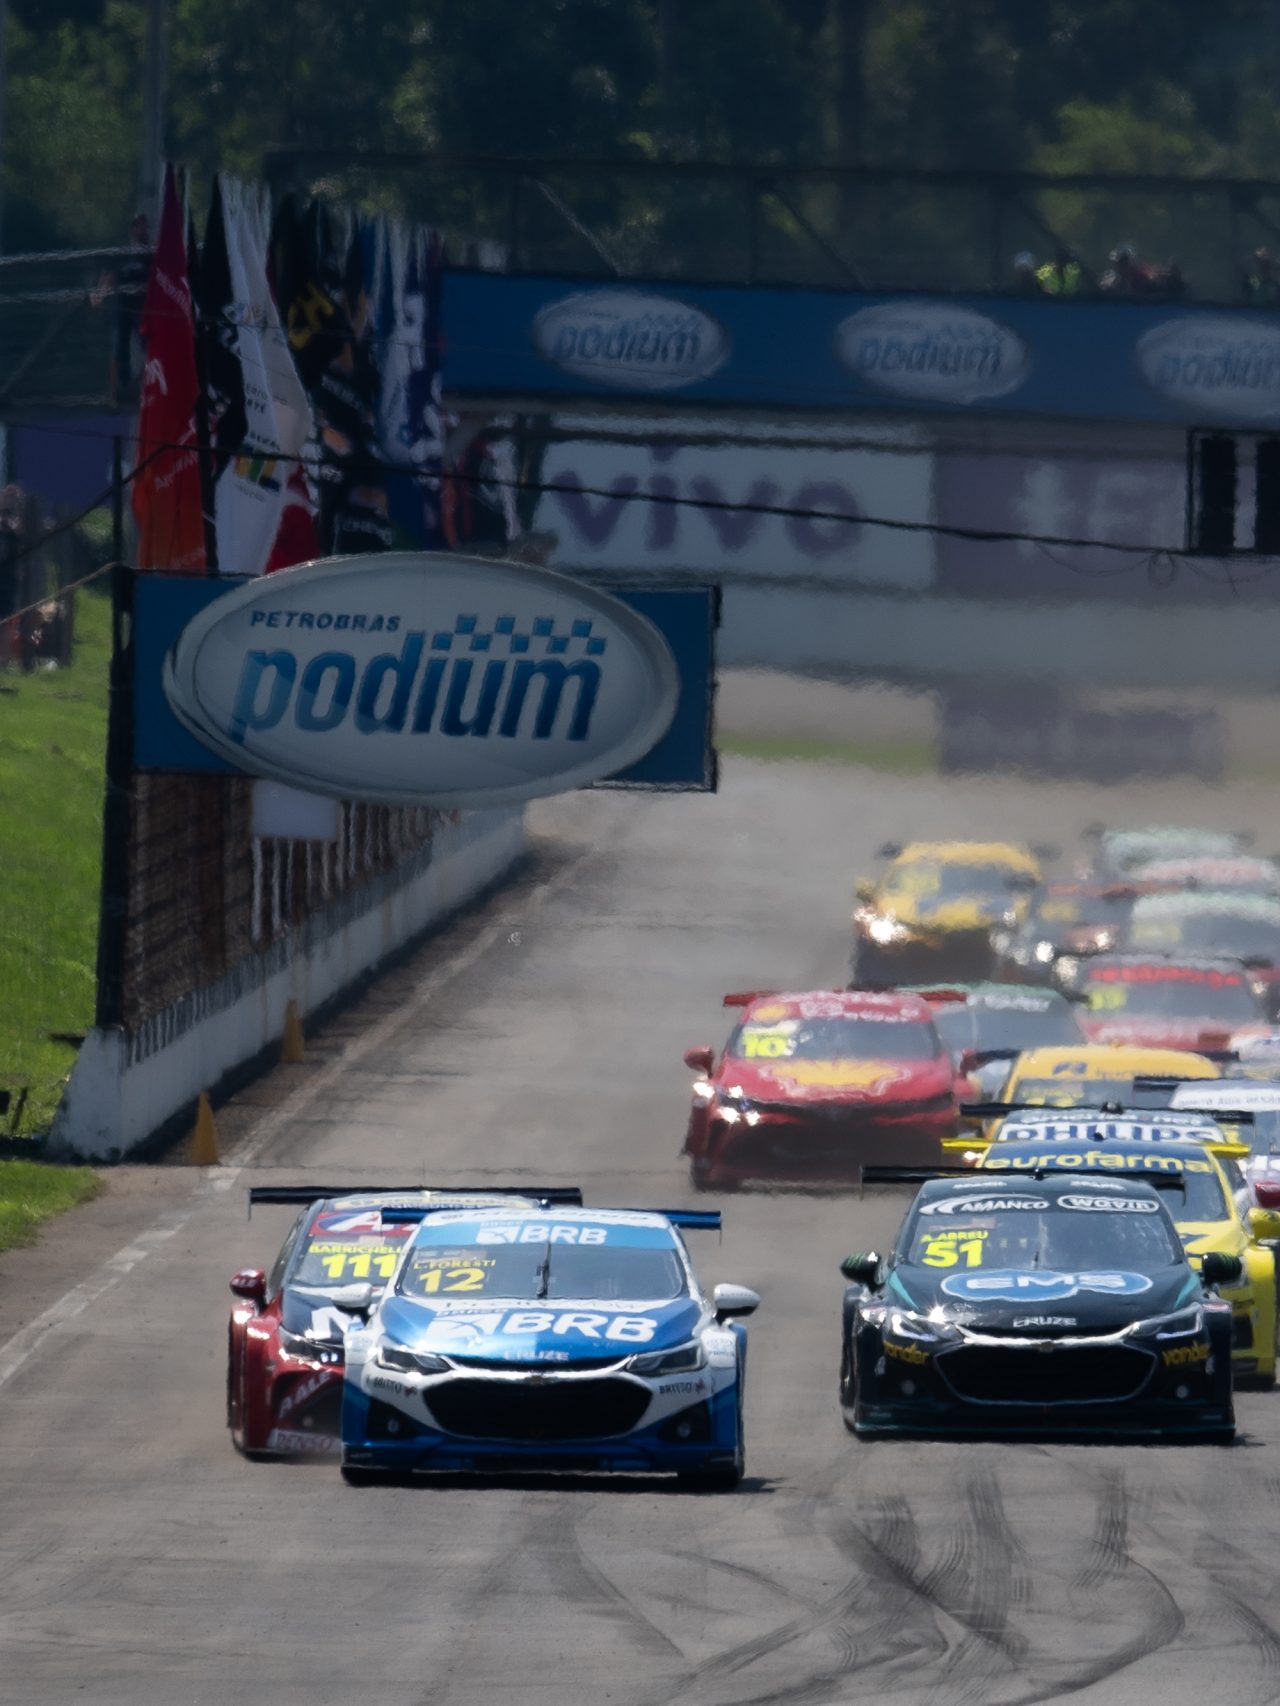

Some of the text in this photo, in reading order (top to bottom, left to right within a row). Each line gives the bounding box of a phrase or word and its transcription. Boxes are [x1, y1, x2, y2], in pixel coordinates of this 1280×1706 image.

[249, 609, 402, 633] PETROBRAS
[230, 629, 604, 746] podium
[984, 1150, 1216, 1173] eurofarma
[961, 1200, 1050, 1213] AMANCO
[519, 1224, 608, 1245] BRB
[921, 1238, 985, 1269] 51
[321, 1253, 398, 1279] 111
[419, 1267, 486, 1294] 12
[966, 1272, 1127, 1290] EMS
[502, 1311, 659, 1343] BRB
[1012, 1315, 1078, 1328] CRUZE
